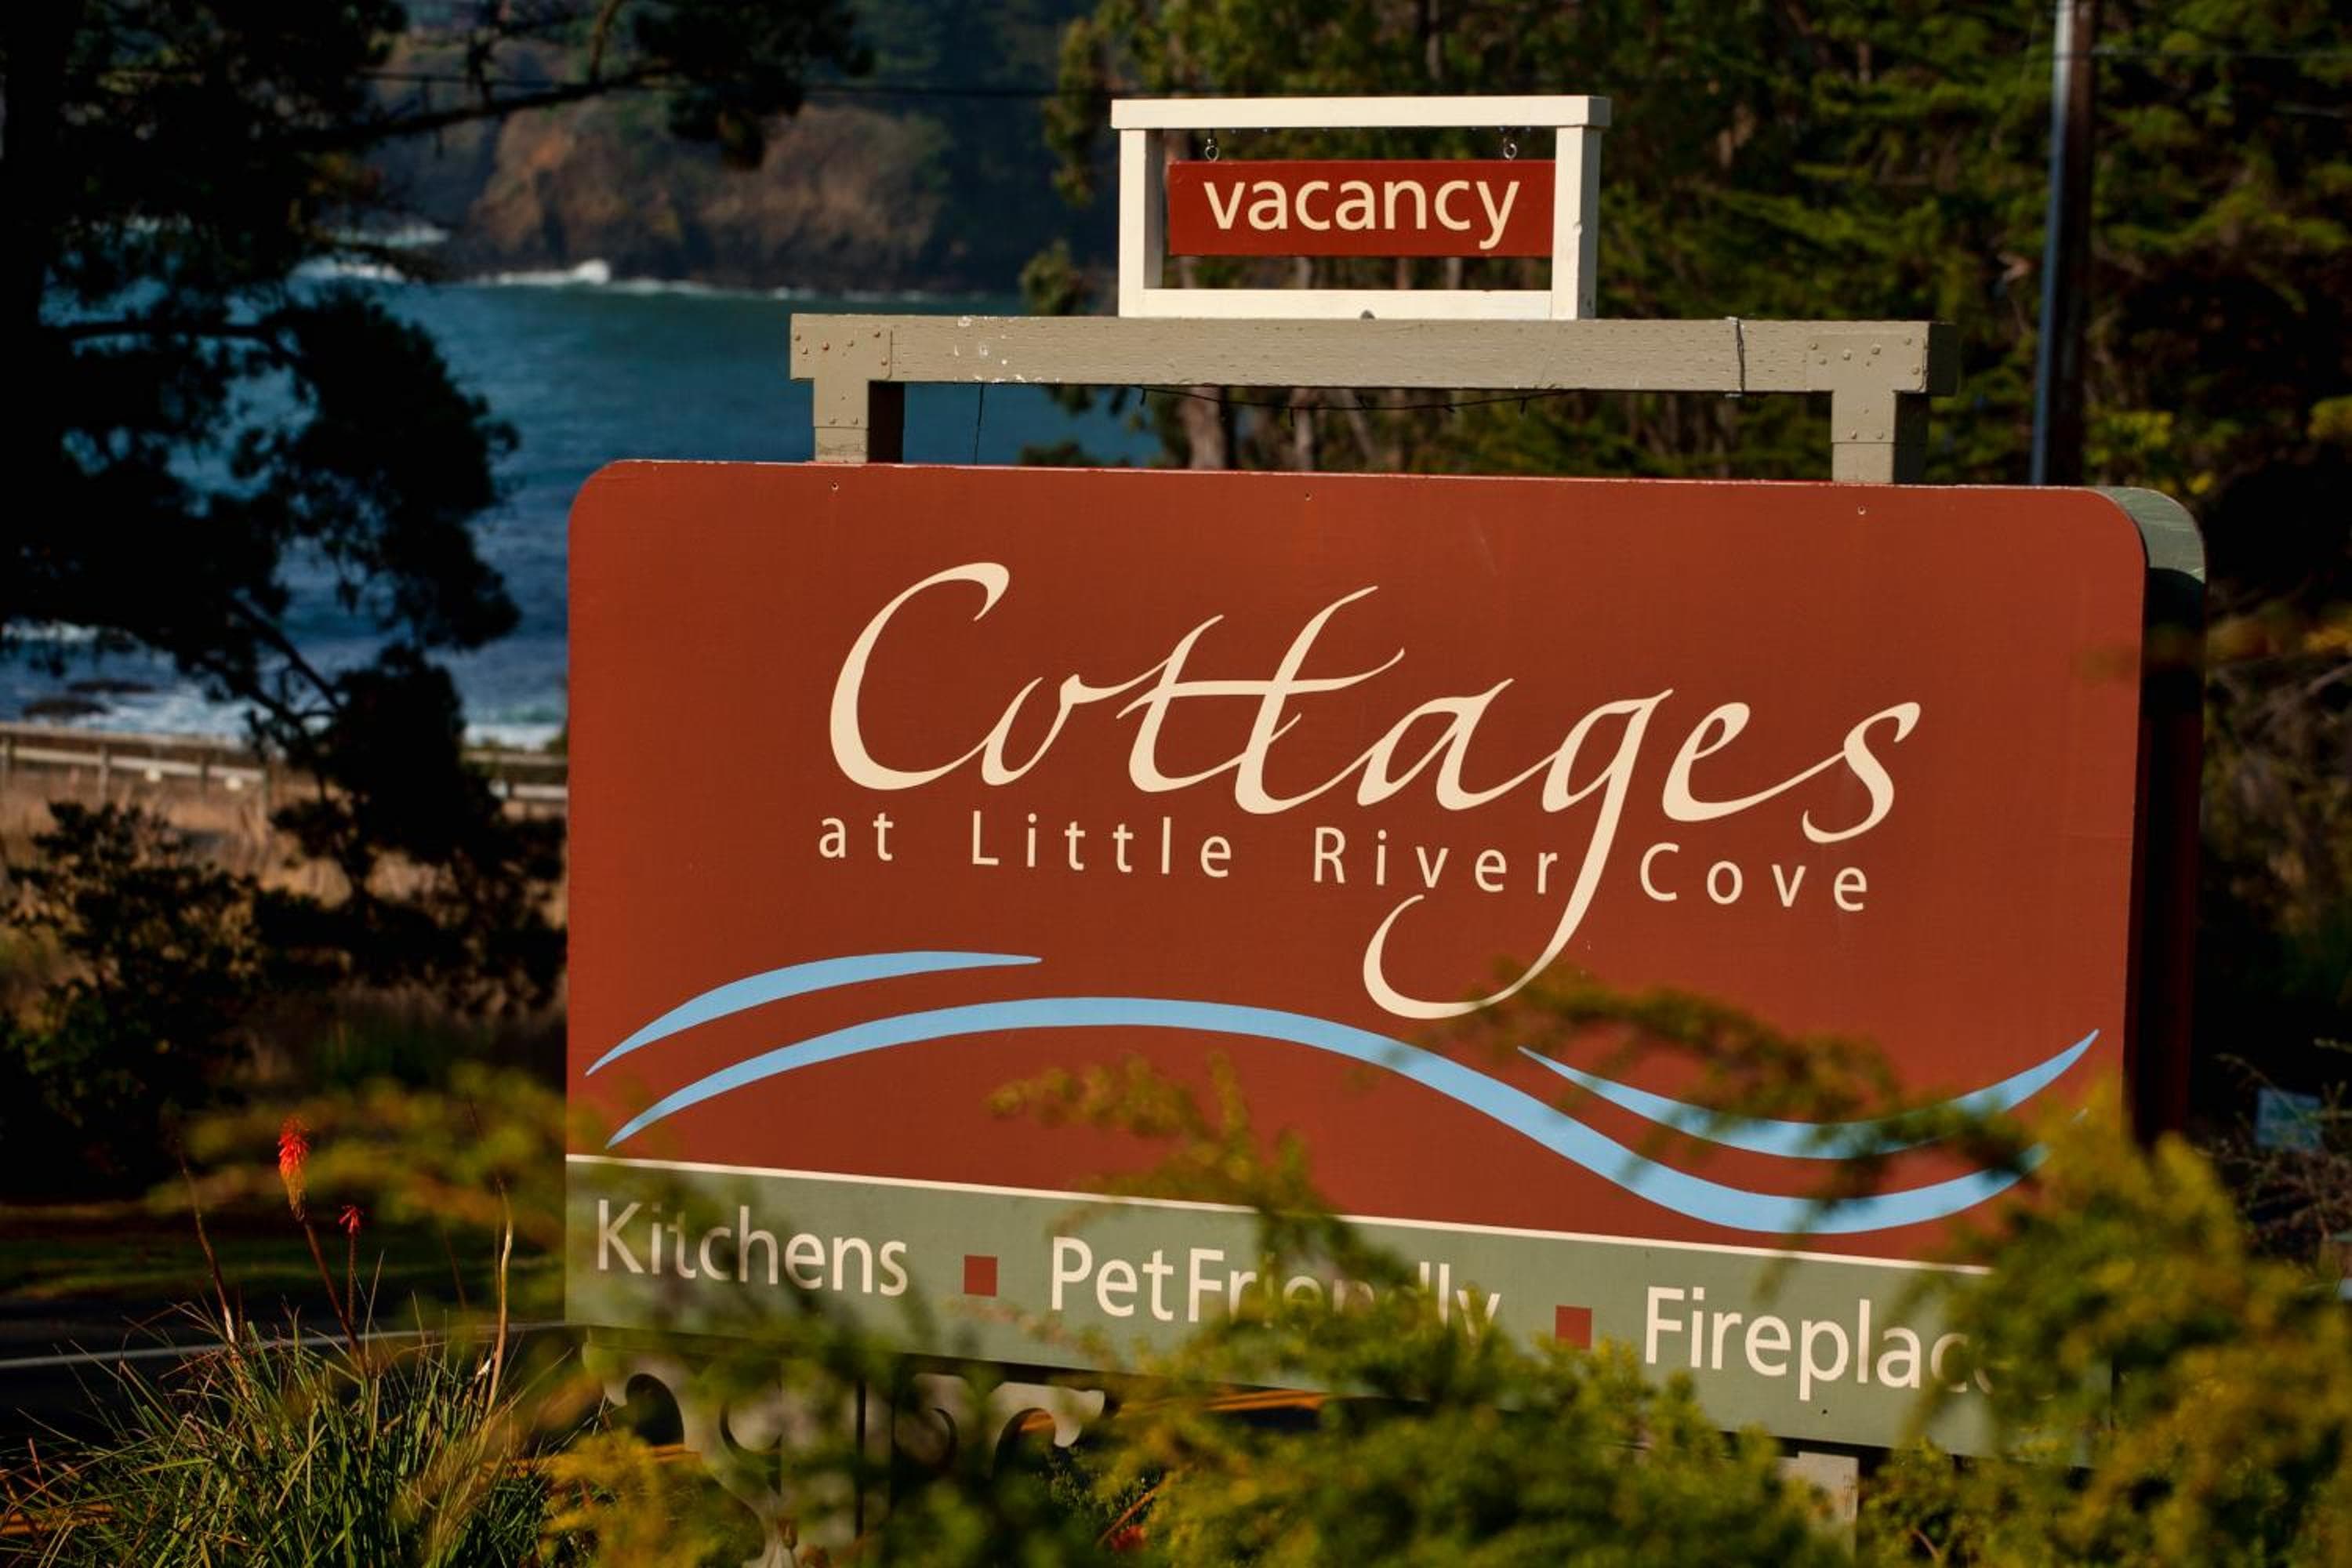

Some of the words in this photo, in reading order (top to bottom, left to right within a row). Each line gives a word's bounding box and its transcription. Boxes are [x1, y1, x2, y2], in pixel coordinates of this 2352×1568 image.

[1203, 180, 1520, 250] vacancy
[829, 561, 1921, 1019] Cottages
[818, 811, 895, 862] at
[971, 810, 1232, 878] Little
[1314, 826, 1559, 895] River
[1640, 842, 1868, 912] Cove
[597, 1199, 908, 1297] Kitchens
[1051, 1236, 1176, 1323] Pet
